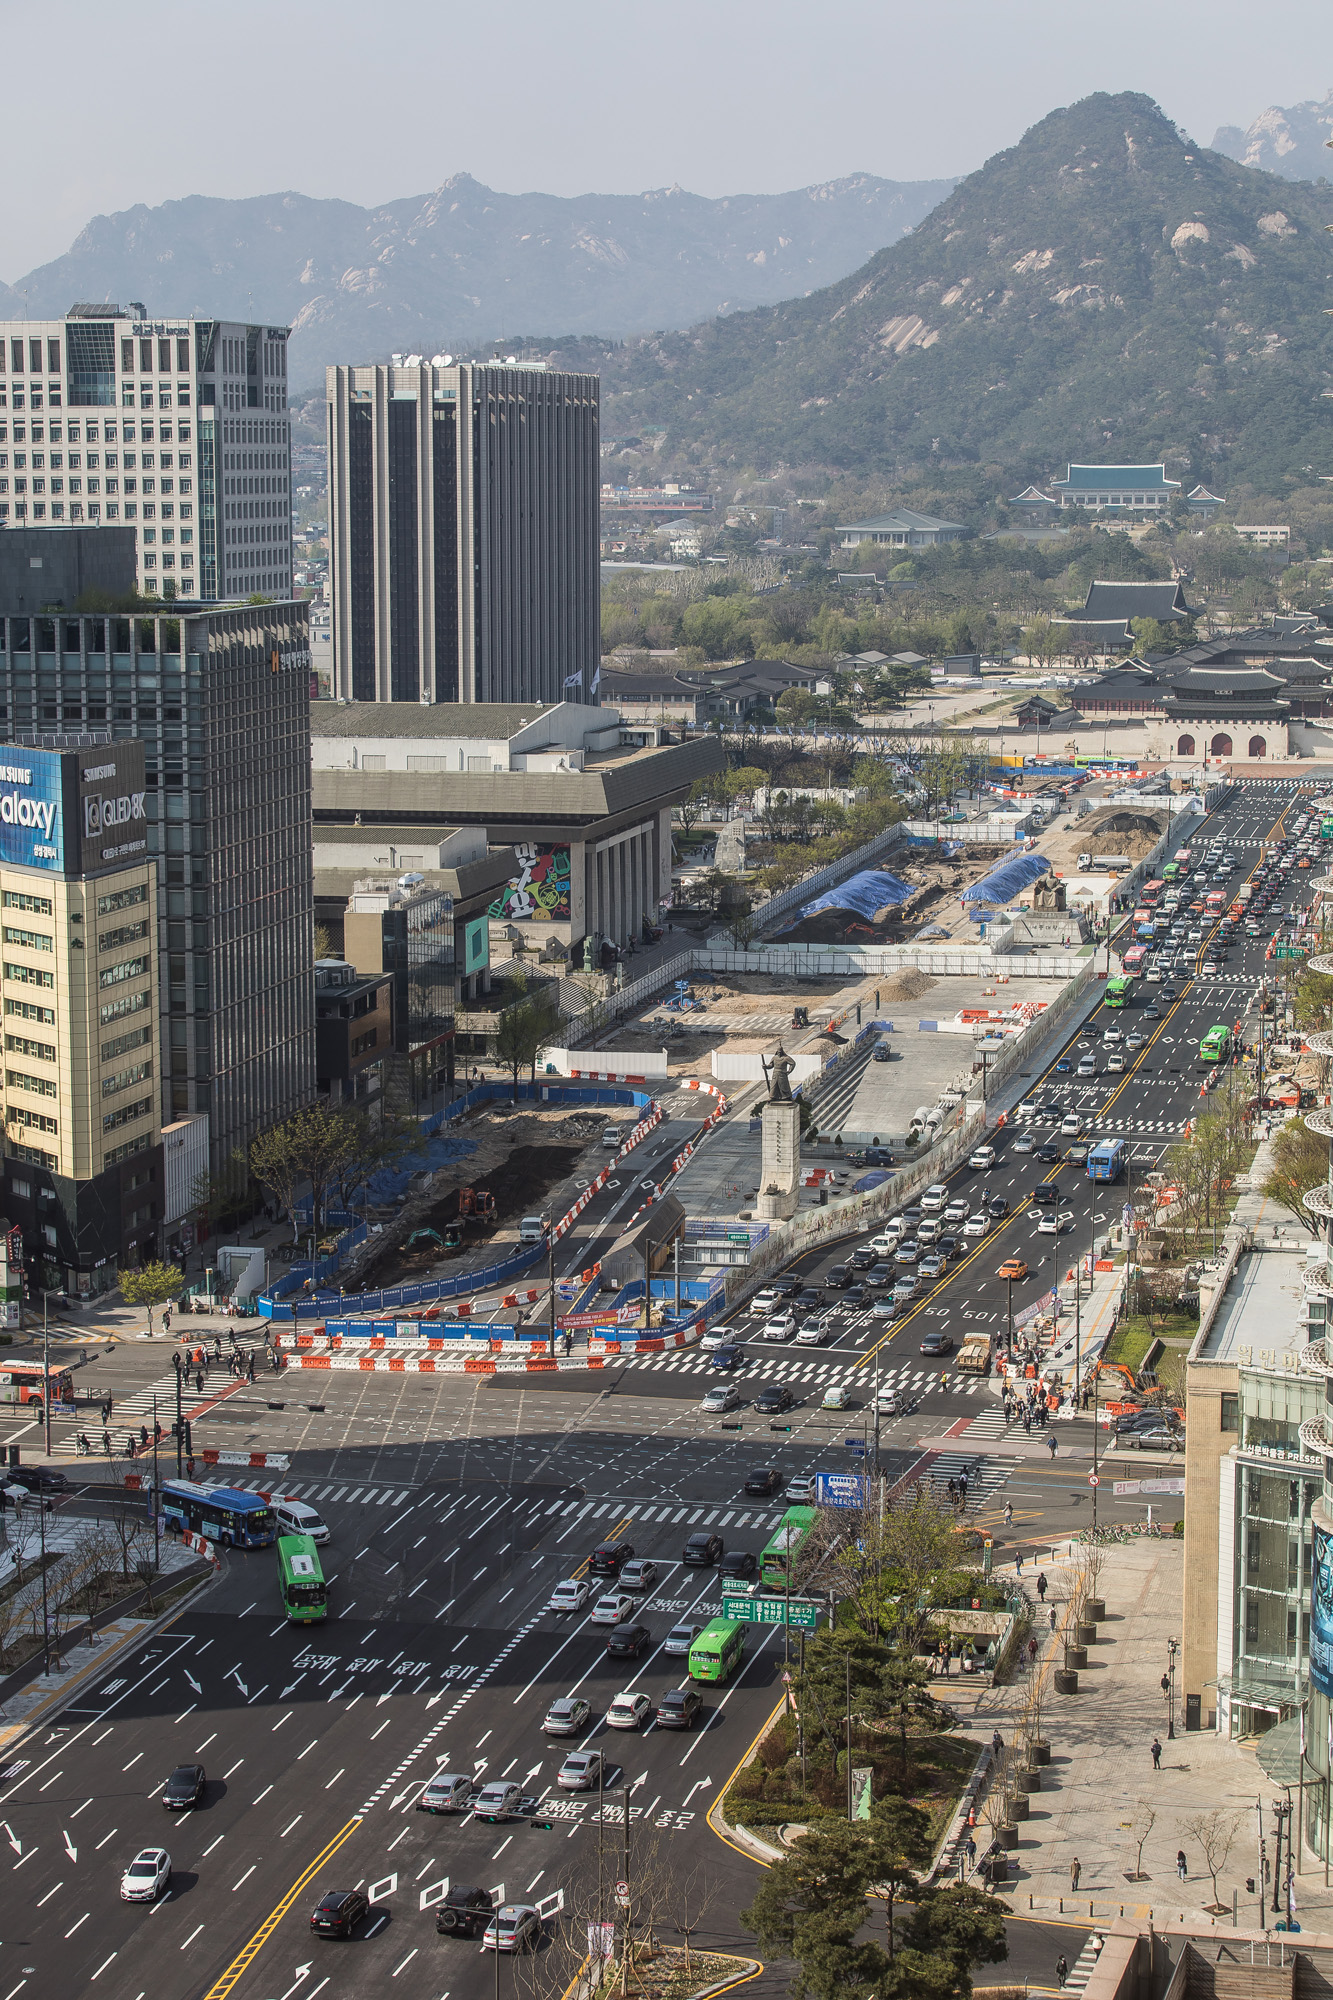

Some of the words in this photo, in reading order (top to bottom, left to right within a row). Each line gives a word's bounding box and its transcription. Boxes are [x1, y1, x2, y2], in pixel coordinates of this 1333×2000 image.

[132, 323, 166, 337] 외교부
[166, 327, 191, 337] MOFA
[84, 763, 117, 783] SAMSUNG
[0, 790, 56, 840] alaxy
[102, 796, 131, 827] QLED
[131, 791, 147, 820] 8K
[616, 1308, 629, 1324] 12
[1247, 1444, 1286, 1460] 신문박물관
[646, 1598, 689, 1613] 광화문
[728, 1602, 751, 1610] 서대문역
[764, 1609, 783, 1617] 광화문
[788, 1607, 813, 1615] 종로1가
[293, 1654, 342, 1670] 서소문
[345, 1657, 385, 1673] 시청
[392, 1661, 431, 1676] 시청
[440, 1664, 479, 1680] 시청
[535, 1799, 589, 1820] 광화문
[590, 1803, 644, 1825] 광화문
[655, 1808, 696, 1830] 종로
